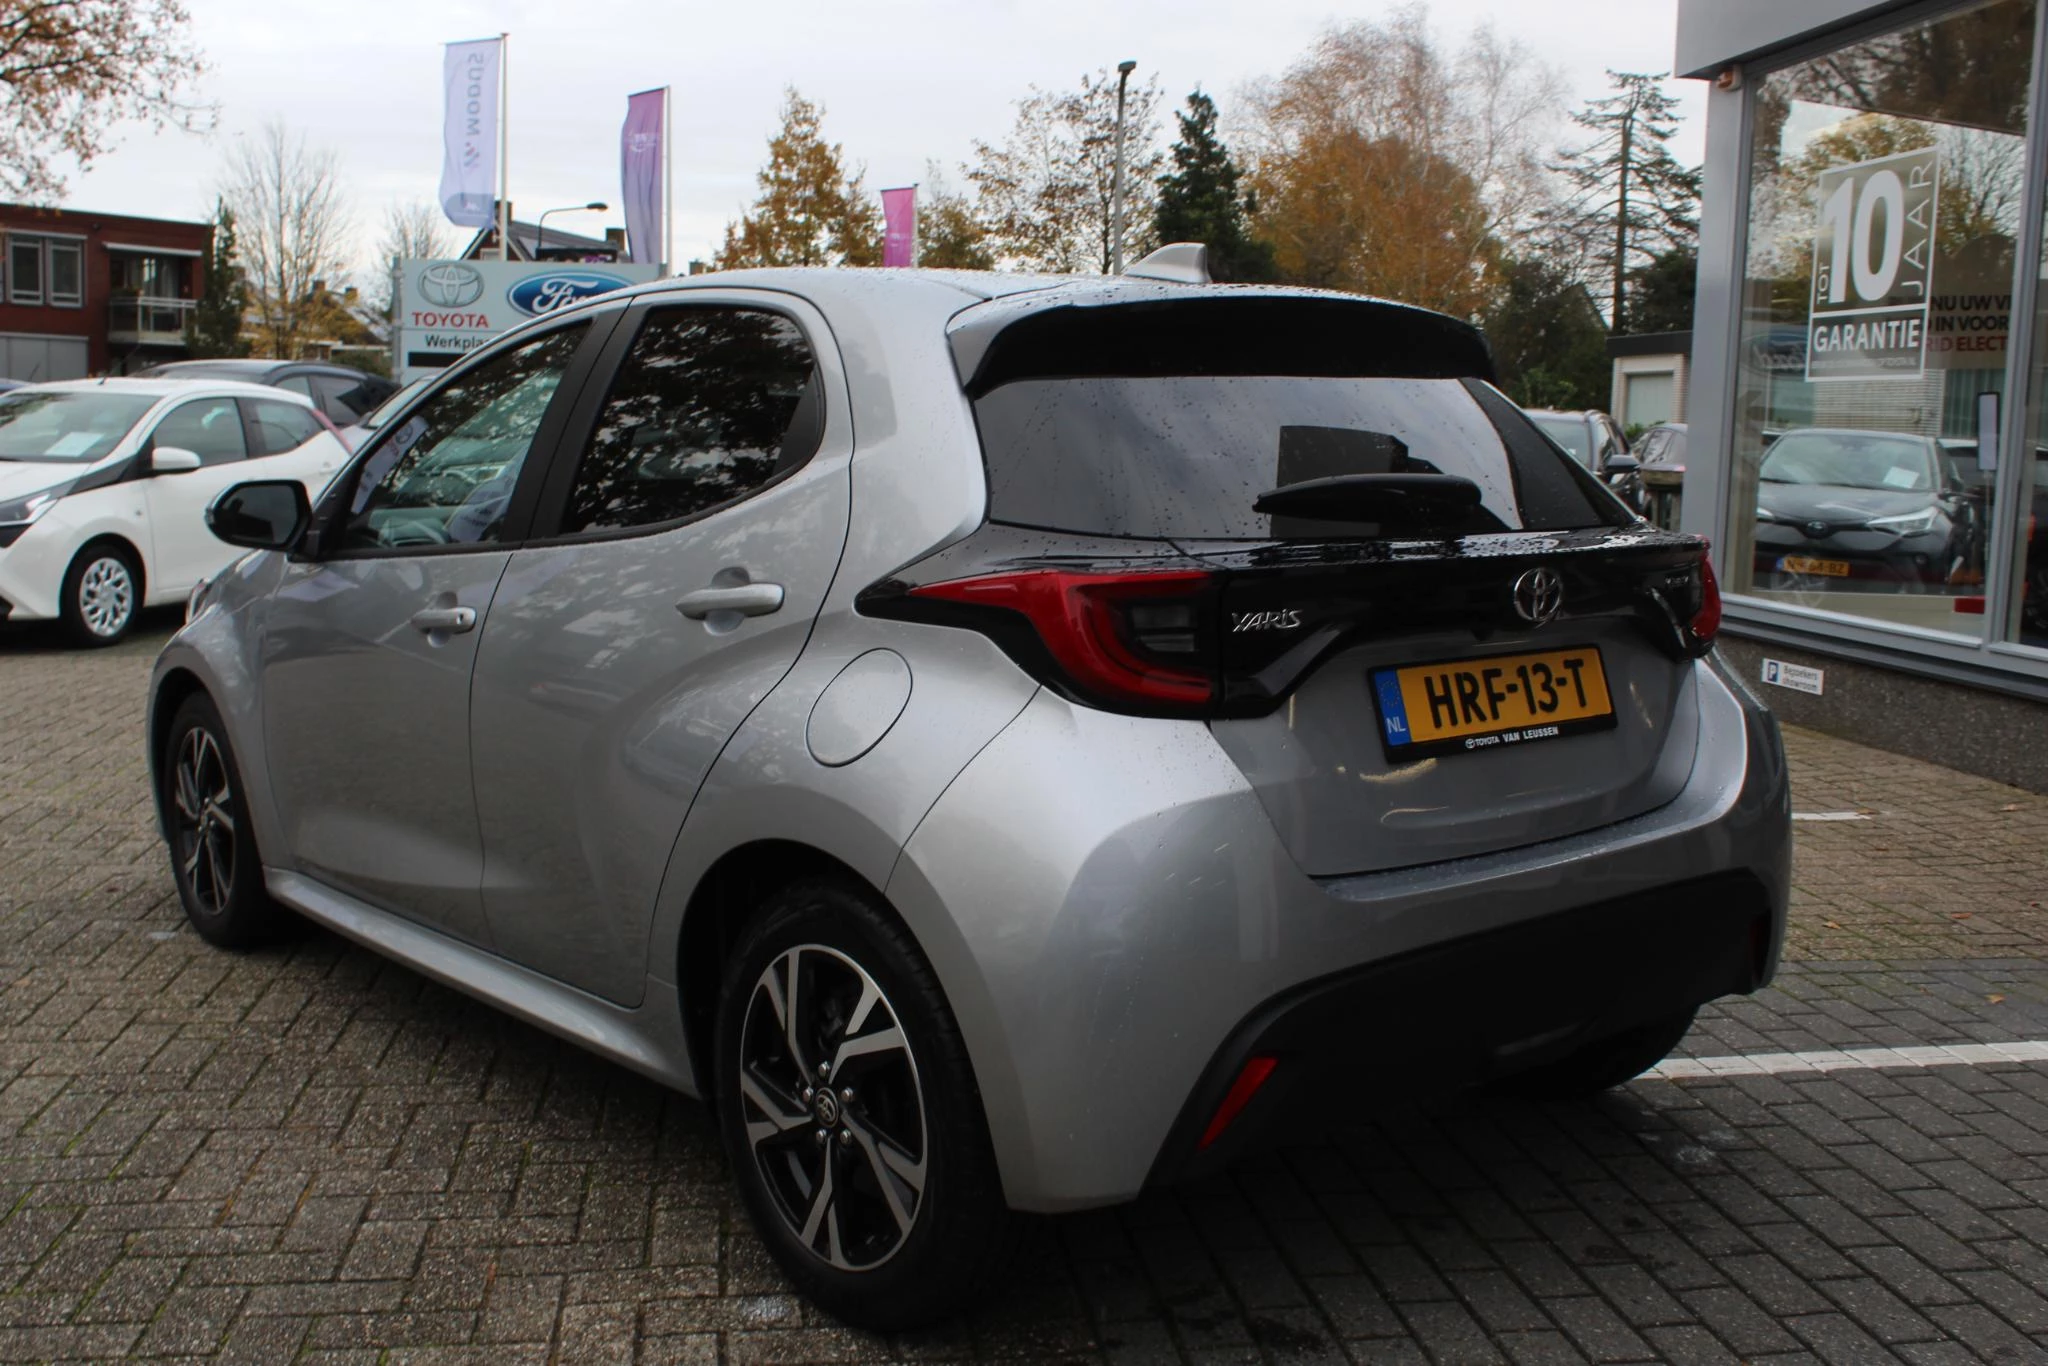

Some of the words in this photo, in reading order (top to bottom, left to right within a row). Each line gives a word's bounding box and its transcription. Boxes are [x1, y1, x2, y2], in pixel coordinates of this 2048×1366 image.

[1823, 169, 1904, 304] 10
[1902, 161, 1933, 296] JAAR
[1816, 264, 1830, 305] TOT
[1959, 295, 1992, 311] UW
[412, 312, 489, 328] TOYOTA
[425, 333, 489, 351] Werkpla
[1813, 319, 1920, 352] GARANTIE
[1424, 657, 1588, 729] HRF-13-T
[1386, 715, 1406, 734] NL
[1474, 737, 1500, 747] TOYOTA
[1502, 732, 1521, 743] VAN
[1523, 726, 1559, 740] LEUSSEN
